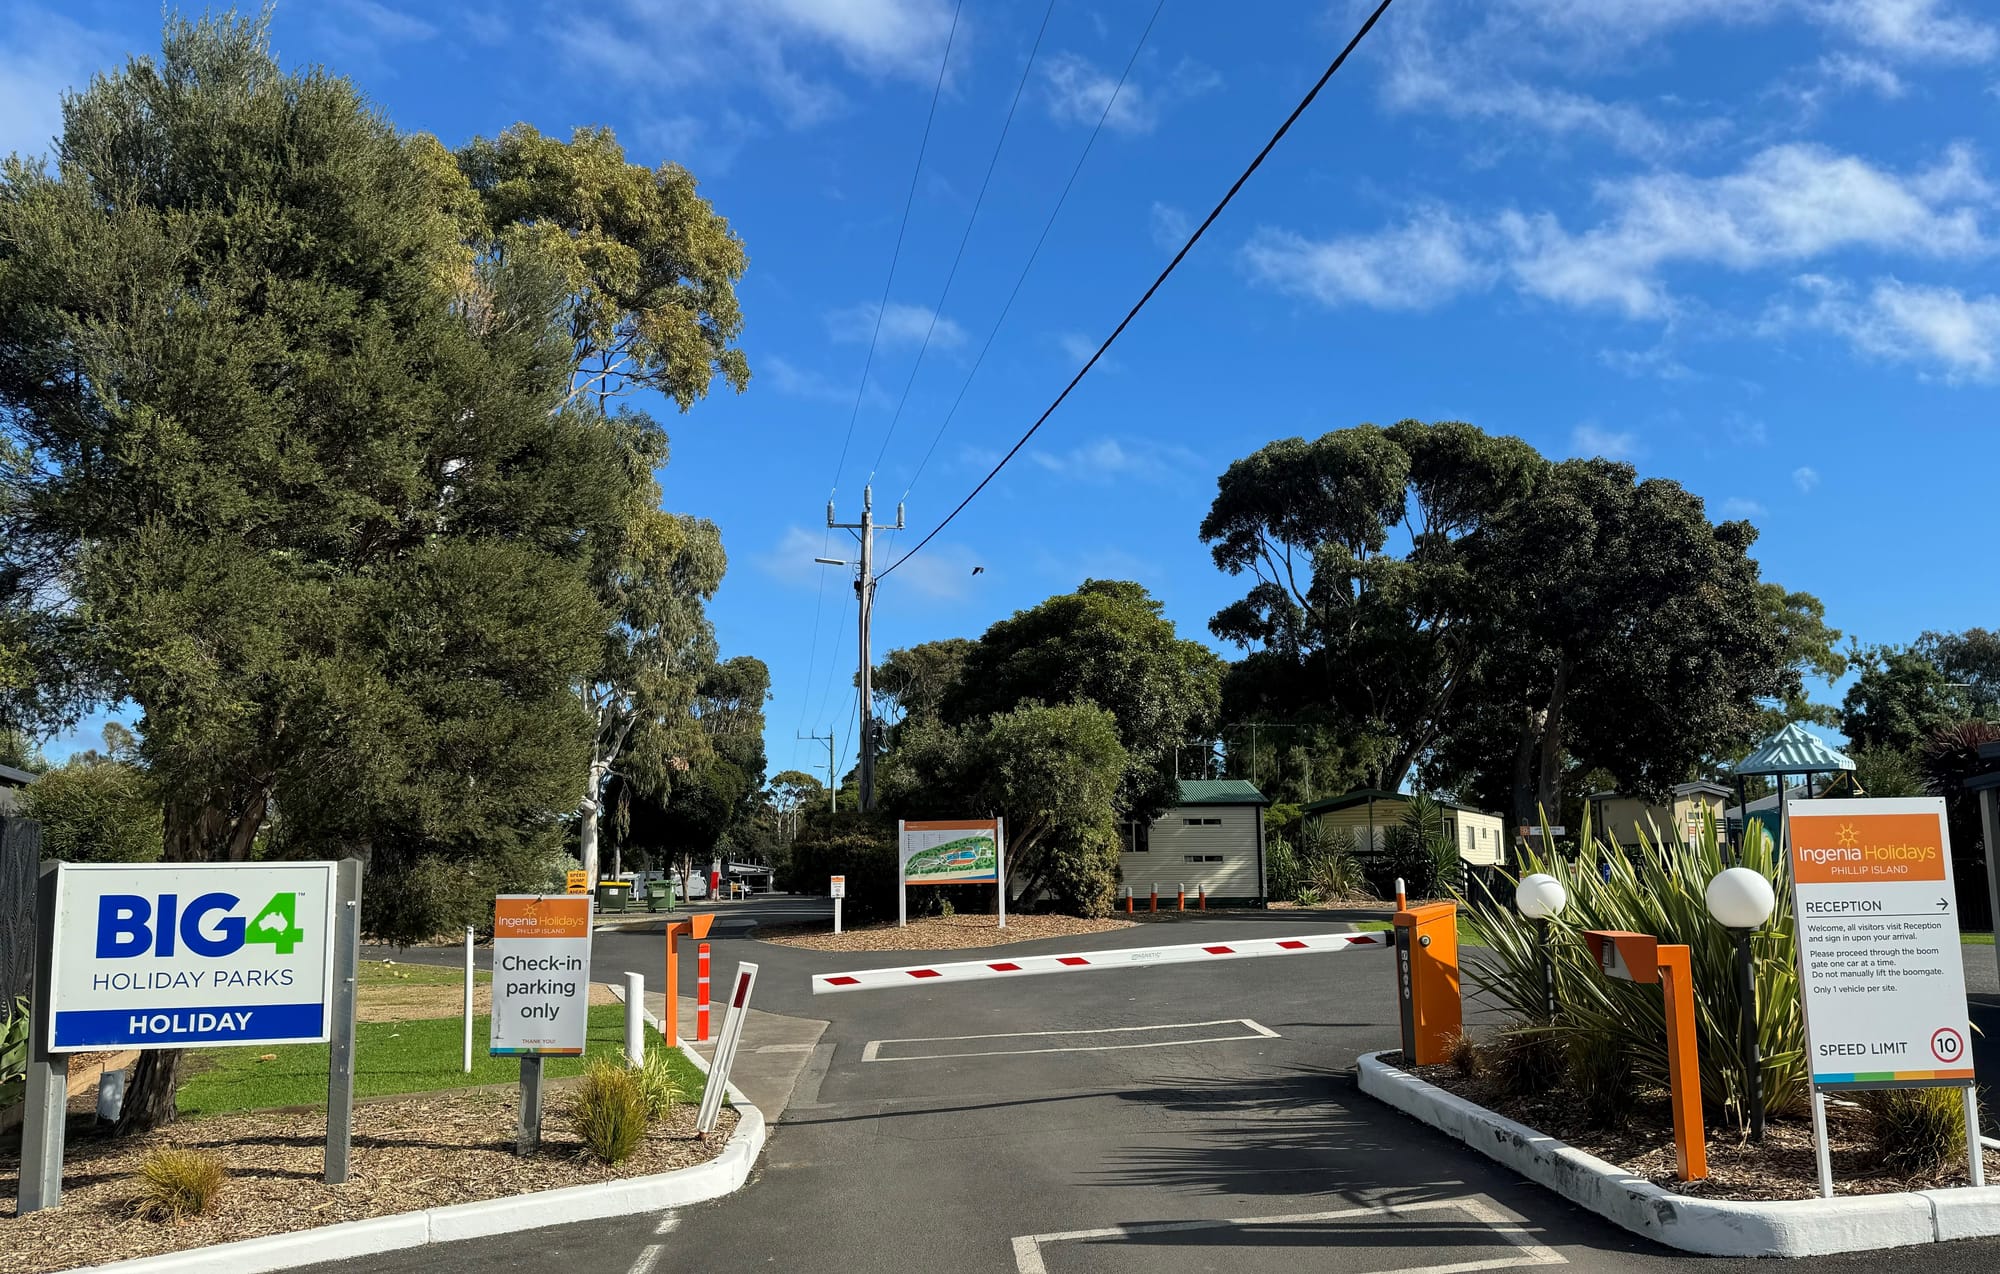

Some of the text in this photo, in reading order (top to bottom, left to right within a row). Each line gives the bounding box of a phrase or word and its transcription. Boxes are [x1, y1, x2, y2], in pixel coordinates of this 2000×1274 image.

[1799, 844, 1936, 864] Ingenia Holidays
[1831, 865, 1908, 875] PHILLIP ISLAND
[1806, 900, 1882, 913] RECEPTION
[95, 892, 304, 959] BIG4
[498, 916, 584, 928] Ingenia Holidays
[1808, 921, 1942, 932] Welcome, all visitors visit Reception
[1825, 934, 1841, 943] sign
[1842, 934, 1850, 942] in
[1851, 934, 1872, 942] upon
[1873, 934, 1891, 942] your
[1892, 932, 1918, 940] arrival.
[1836, 949, 1868, 958] proceed
[1869, 948, 1901, 957] through
[1902, 947, 1915, 955] the
[1916, 947, 1940, 955] boom
[502, 955, 582, 971] Check-in
[1811, 961, 1829, 969] gate
[93, 968, 294, 991] HOLIDAY PARKS
[1840, 969, 1875, 978] manually
[1876, 969, 1887, 977] lift
[1902, 968, 1945, 977] boomgate.
[506, 979, 576, 997] parking
[1813, 986, 1831, 994] Only
[520, 1003, 560, 1020] only
[129, 1012, 253, 1034] HOLIDAY
[1819, 1042, 1908, 1056] SPEED LIMIT
[1937, 1038, 1957, 1053] 10
